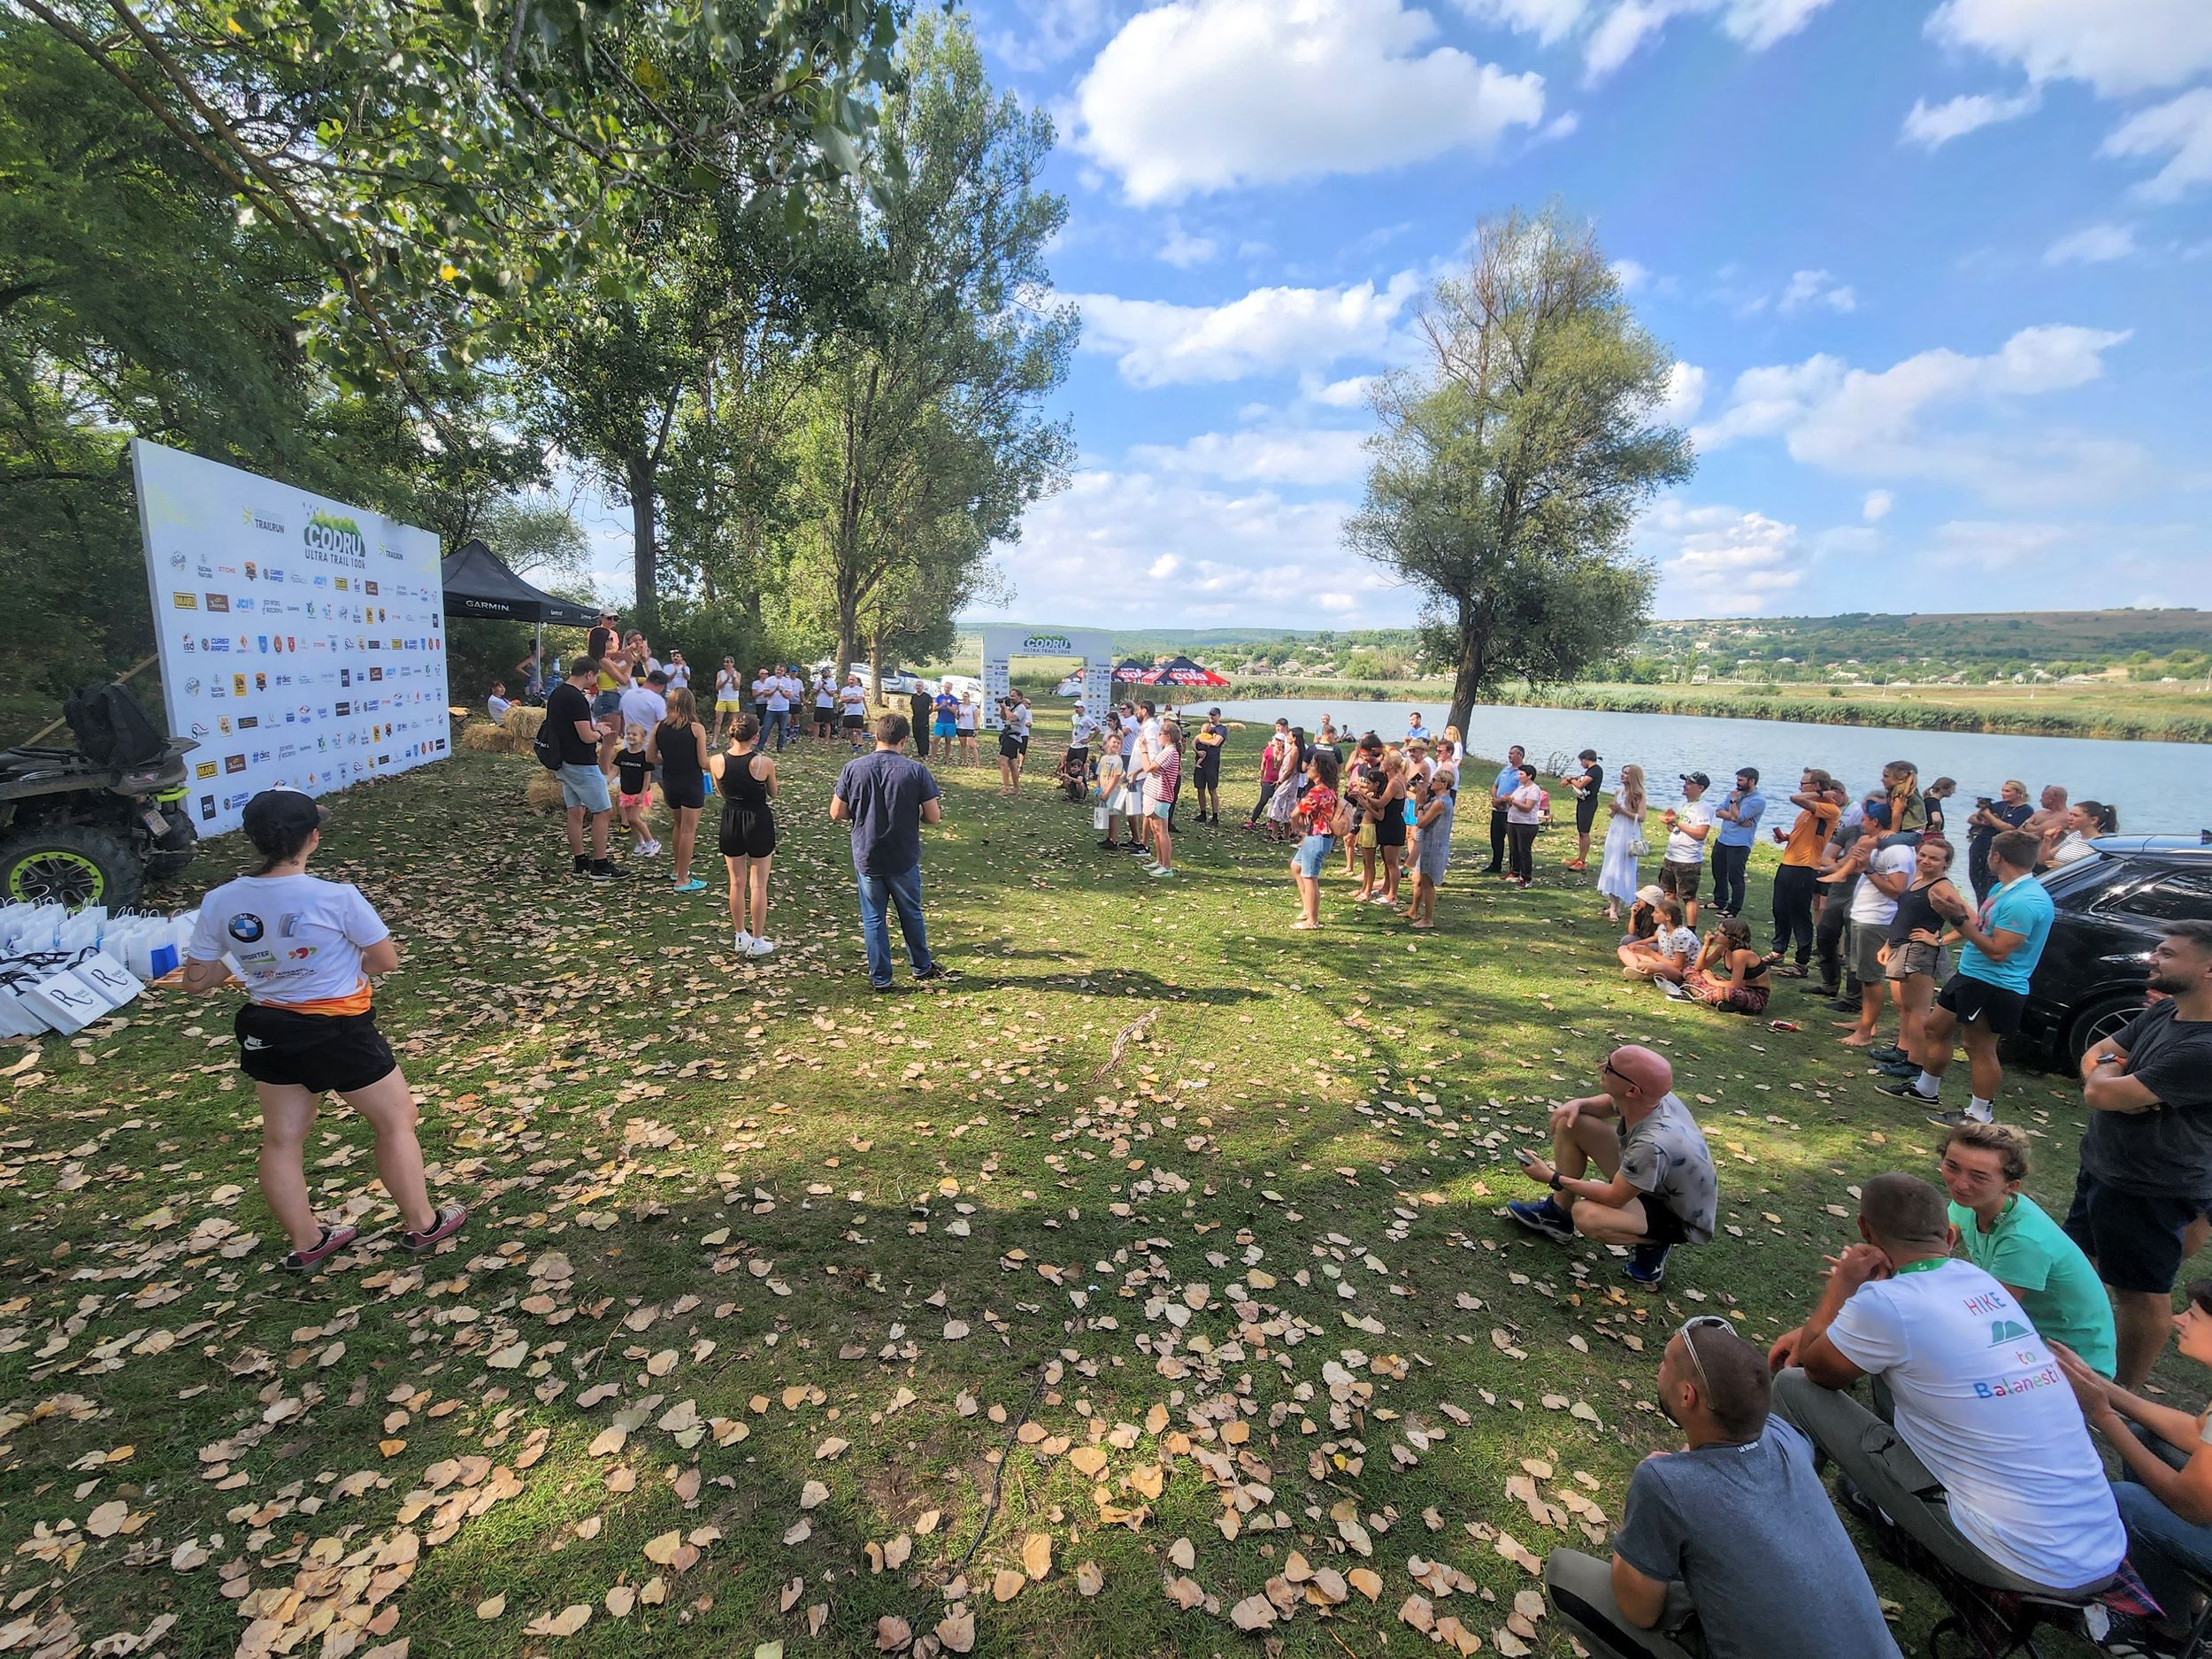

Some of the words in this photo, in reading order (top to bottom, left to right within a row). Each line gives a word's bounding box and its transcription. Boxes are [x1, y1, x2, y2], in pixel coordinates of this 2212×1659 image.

[255, 518, 285, 534] TRAILRUN
[307, 524, 363, 557] CODRU
[304, 549, 328, 563] ULTRA
[331, 554, 349, 566] TRAIL
[465, 600, 510, 611] GARMIN
[1026, 637, 1069, 649] CODRU
[1173, 669, 1209, 680] cola
[90, 968, 128, 987] R
[50, 989, 94, 1008] R
[247, 1034, 263, 1047] NIKE
[1963, 1292, 2007, 1316] HIKE
[2016, 1351, 2036, 1364] to
[1973, 1363, 2060, 1399] Balanesti
